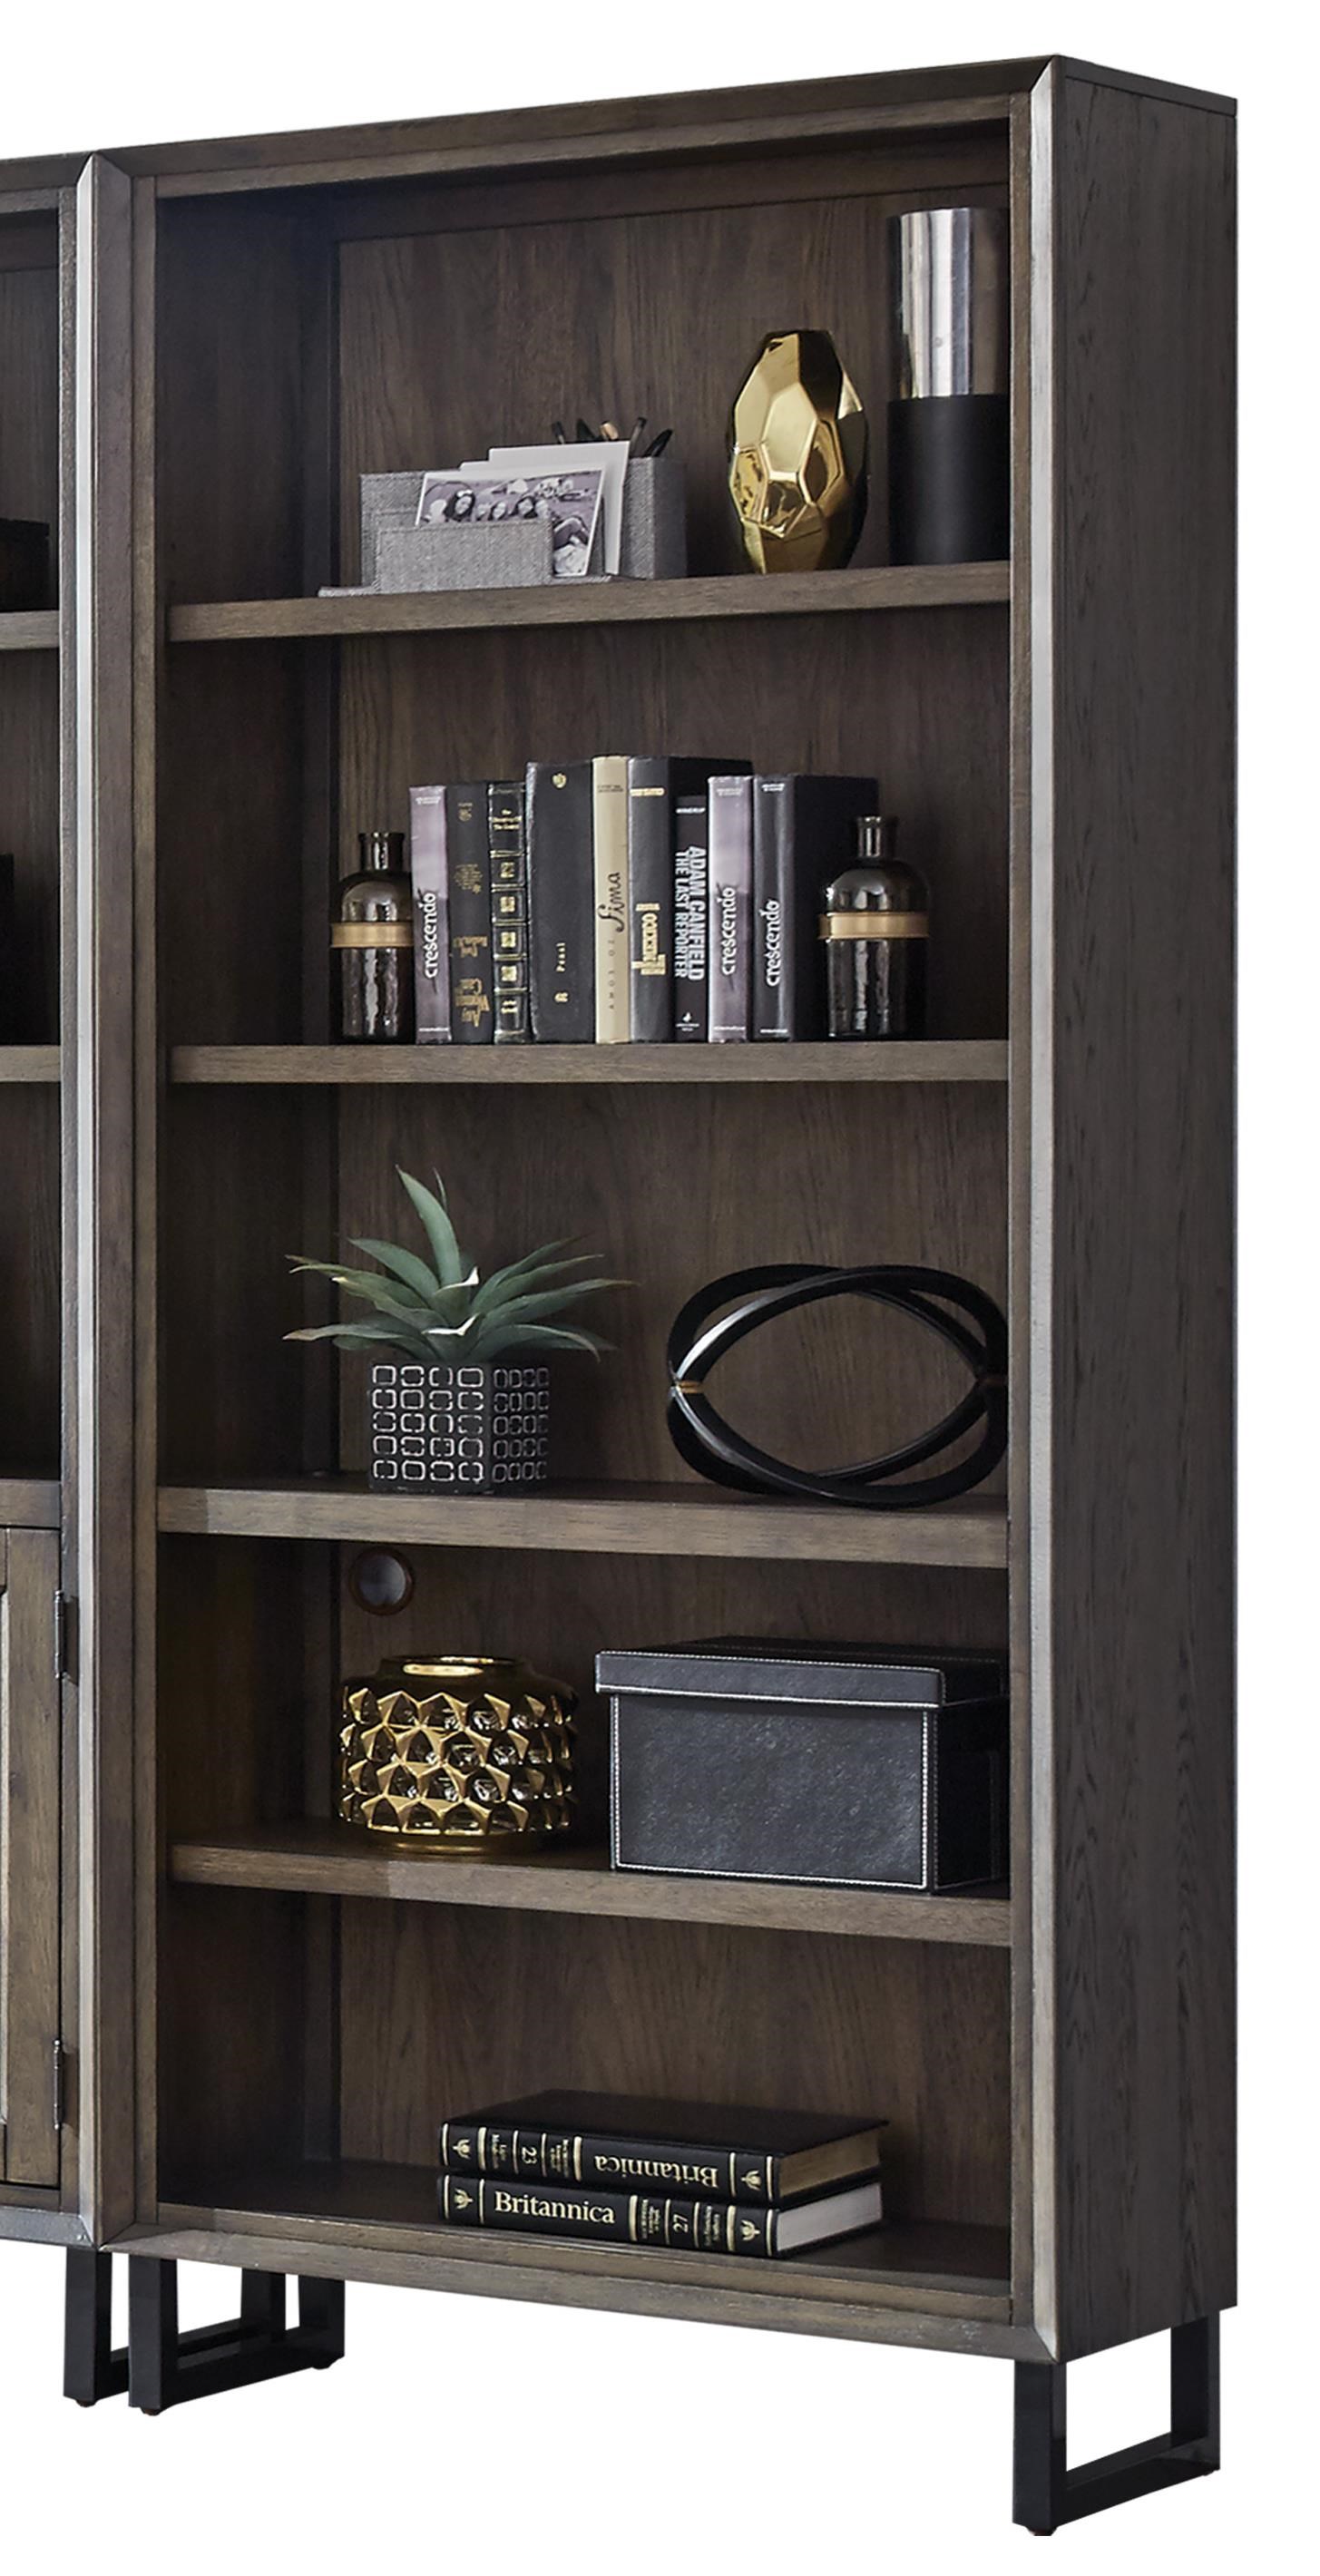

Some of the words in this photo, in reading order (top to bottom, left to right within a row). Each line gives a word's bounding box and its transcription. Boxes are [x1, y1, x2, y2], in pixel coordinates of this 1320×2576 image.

[675, 850, 689, 875] THE
[689, 845, 707, 896] ADAM
[675, 878, 690, 909] LAST
[418, 893, 438, 979] crescendo
[674, 912, 689, 979] REPORTER
[688, 900, 707, 981] CANFIELD
[716, 887, 738, 976] crescendo
[758, 900, 782, 987] crescendo
[521, 2146, 538, 2164] 23
[594, 2155, 719, 2189] Britannica
[494, 2191, 616, 2224] Britannica
[672, 2213, 689, 2233] 27
